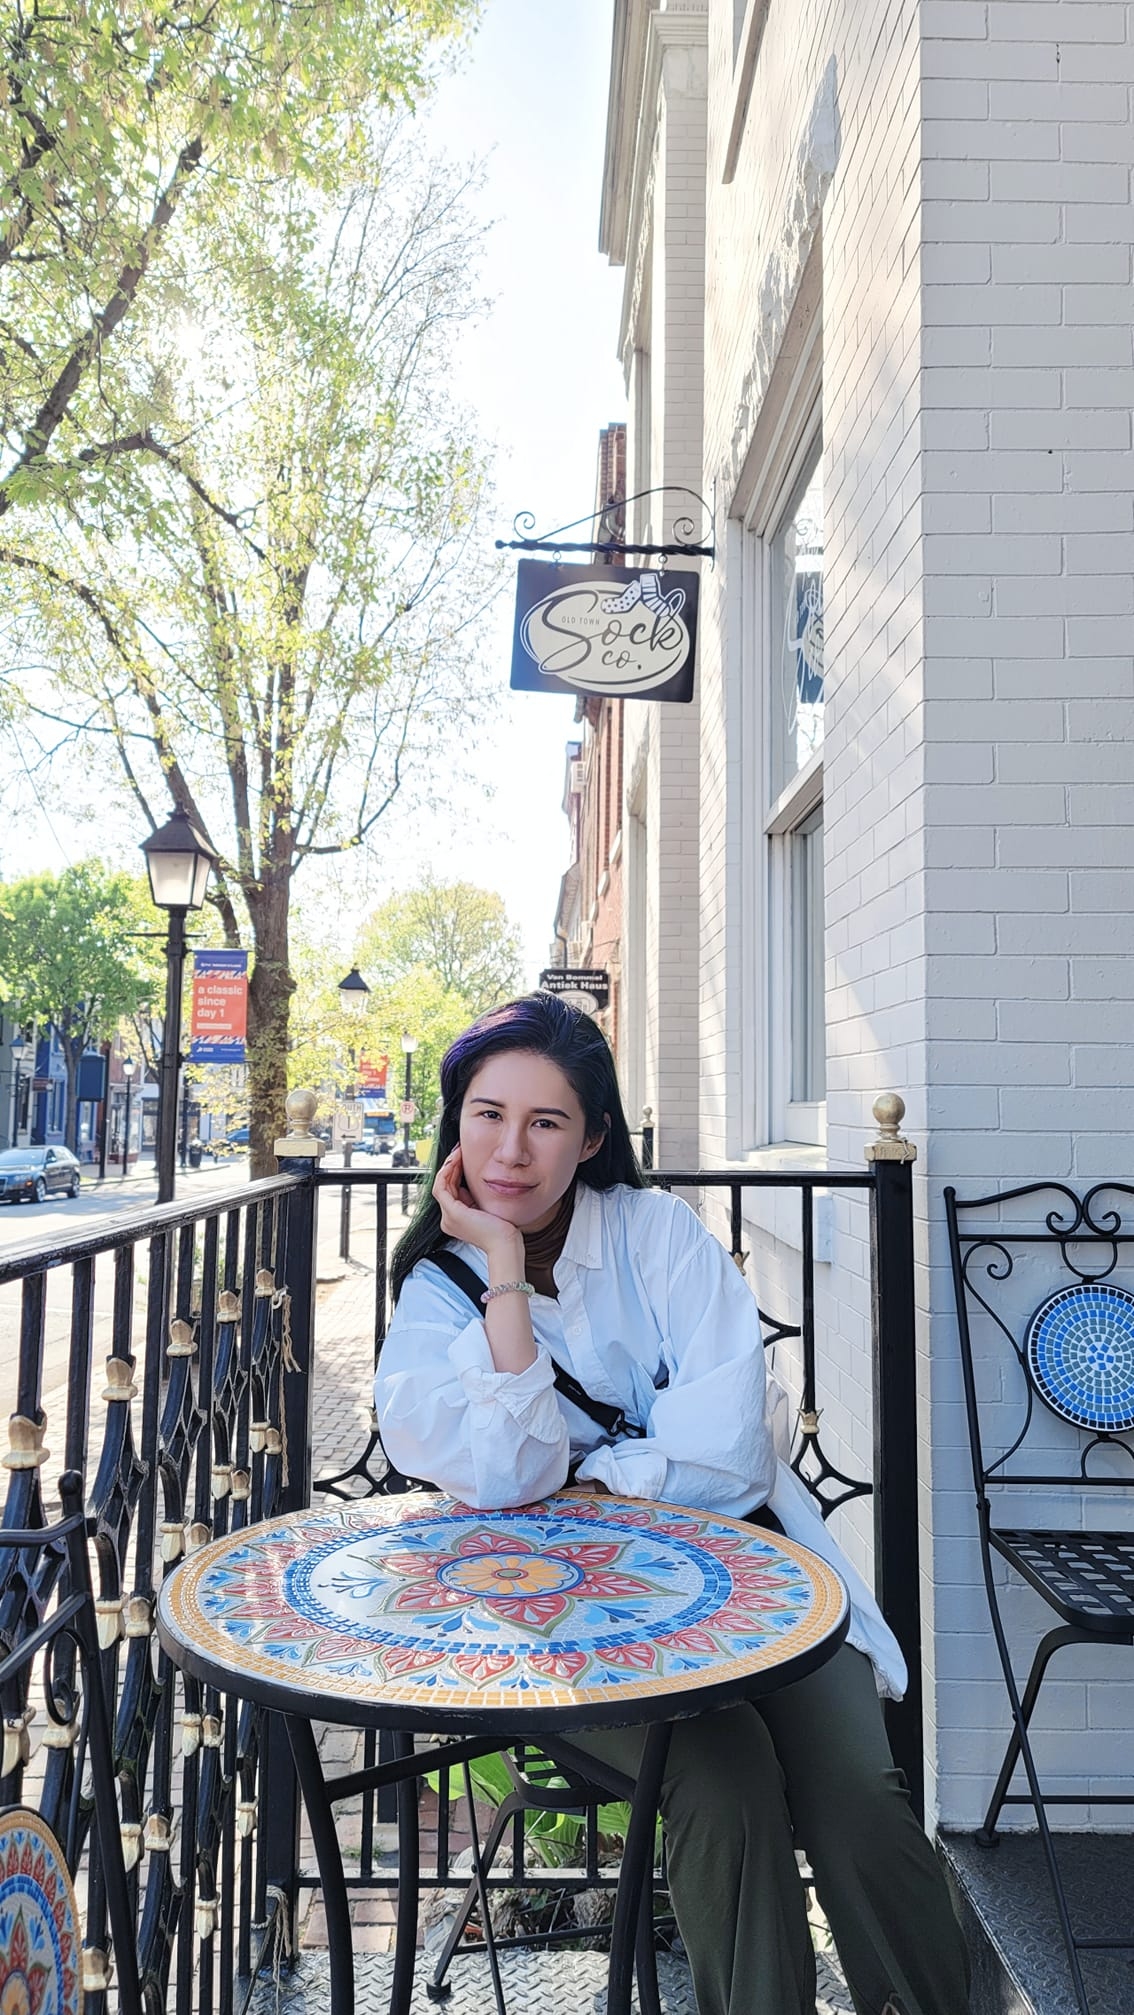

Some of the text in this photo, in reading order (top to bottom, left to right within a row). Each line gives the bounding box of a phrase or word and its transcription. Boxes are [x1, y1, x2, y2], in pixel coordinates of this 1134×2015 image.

[561, 615, 600, 625] OLD TOWN
[538, 588, 685, 673] Sock
[198, 985, 243, 995] a classic
[541, 981, 608, 990] Antiek Haus
[198, 996, 226, 1006] since
[197, 1007, 225, 1020] day 1
